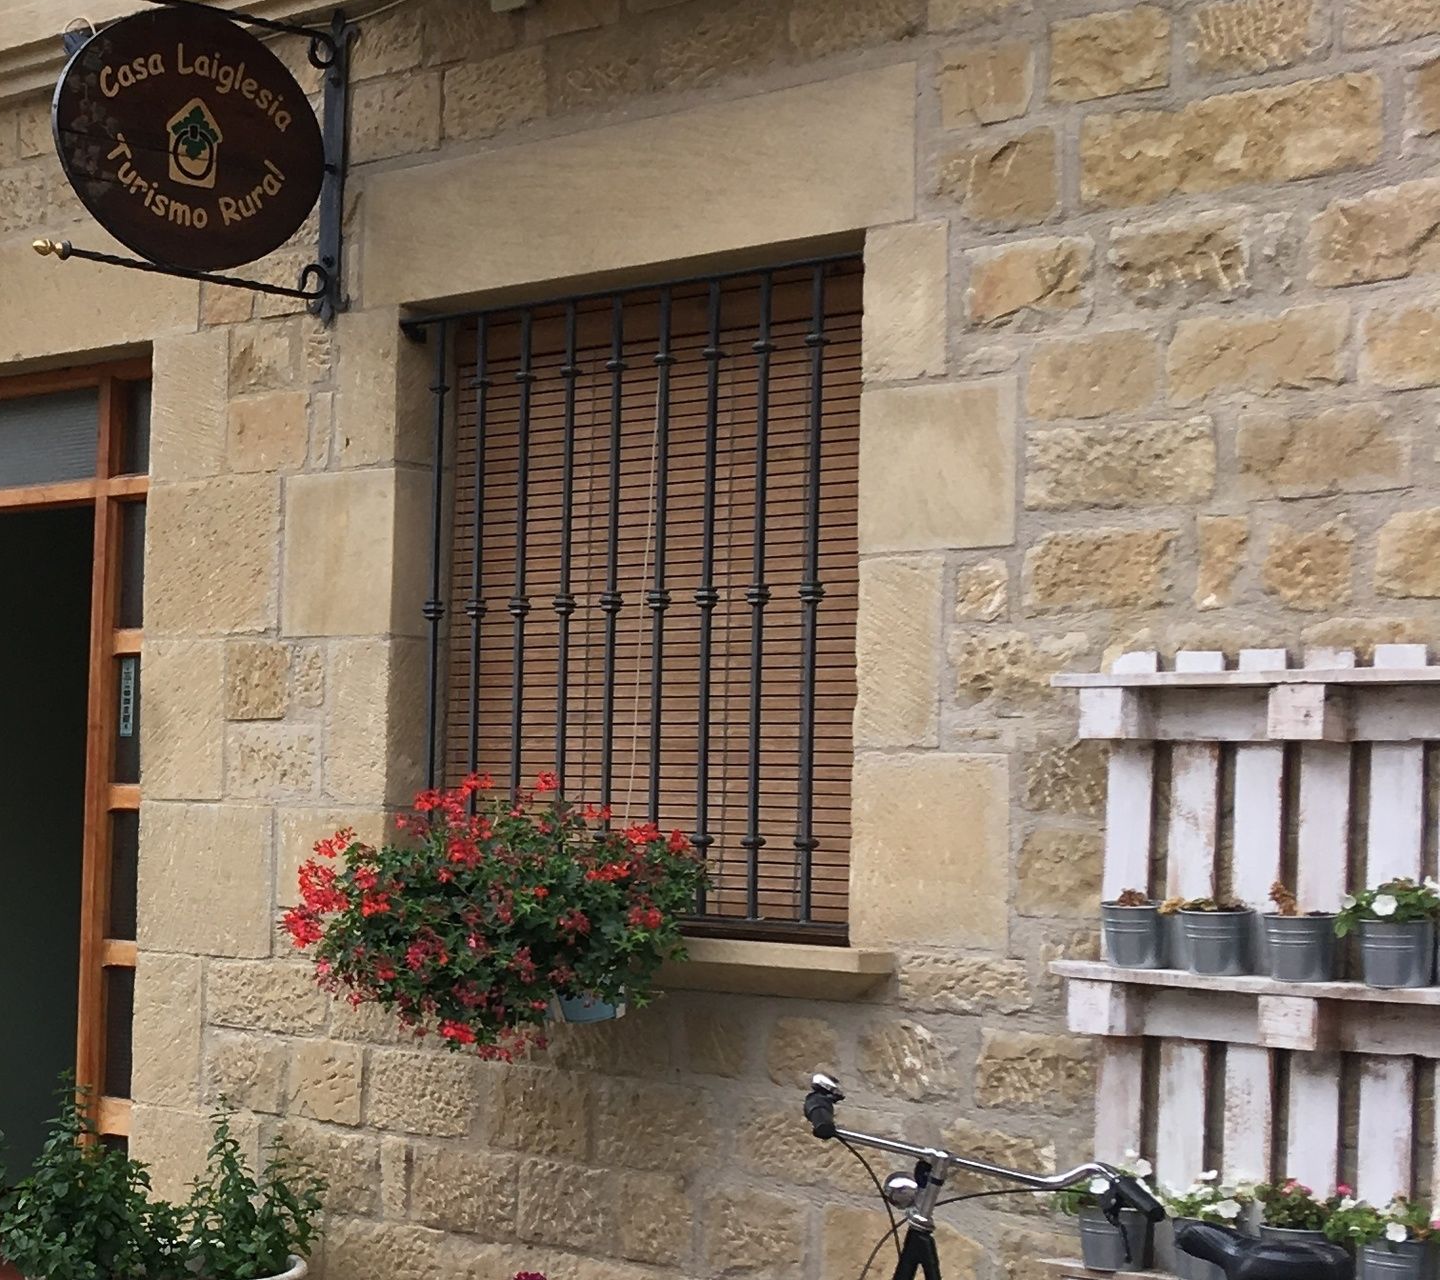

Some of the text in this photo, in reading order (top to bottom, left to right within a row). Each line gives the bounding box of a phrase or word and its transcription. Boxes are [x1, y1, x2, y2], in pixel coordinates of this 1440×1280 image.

[100, 42, 292, 132] Casa Laiglesia
[107, 132, 285, 229] Turismo Rural
